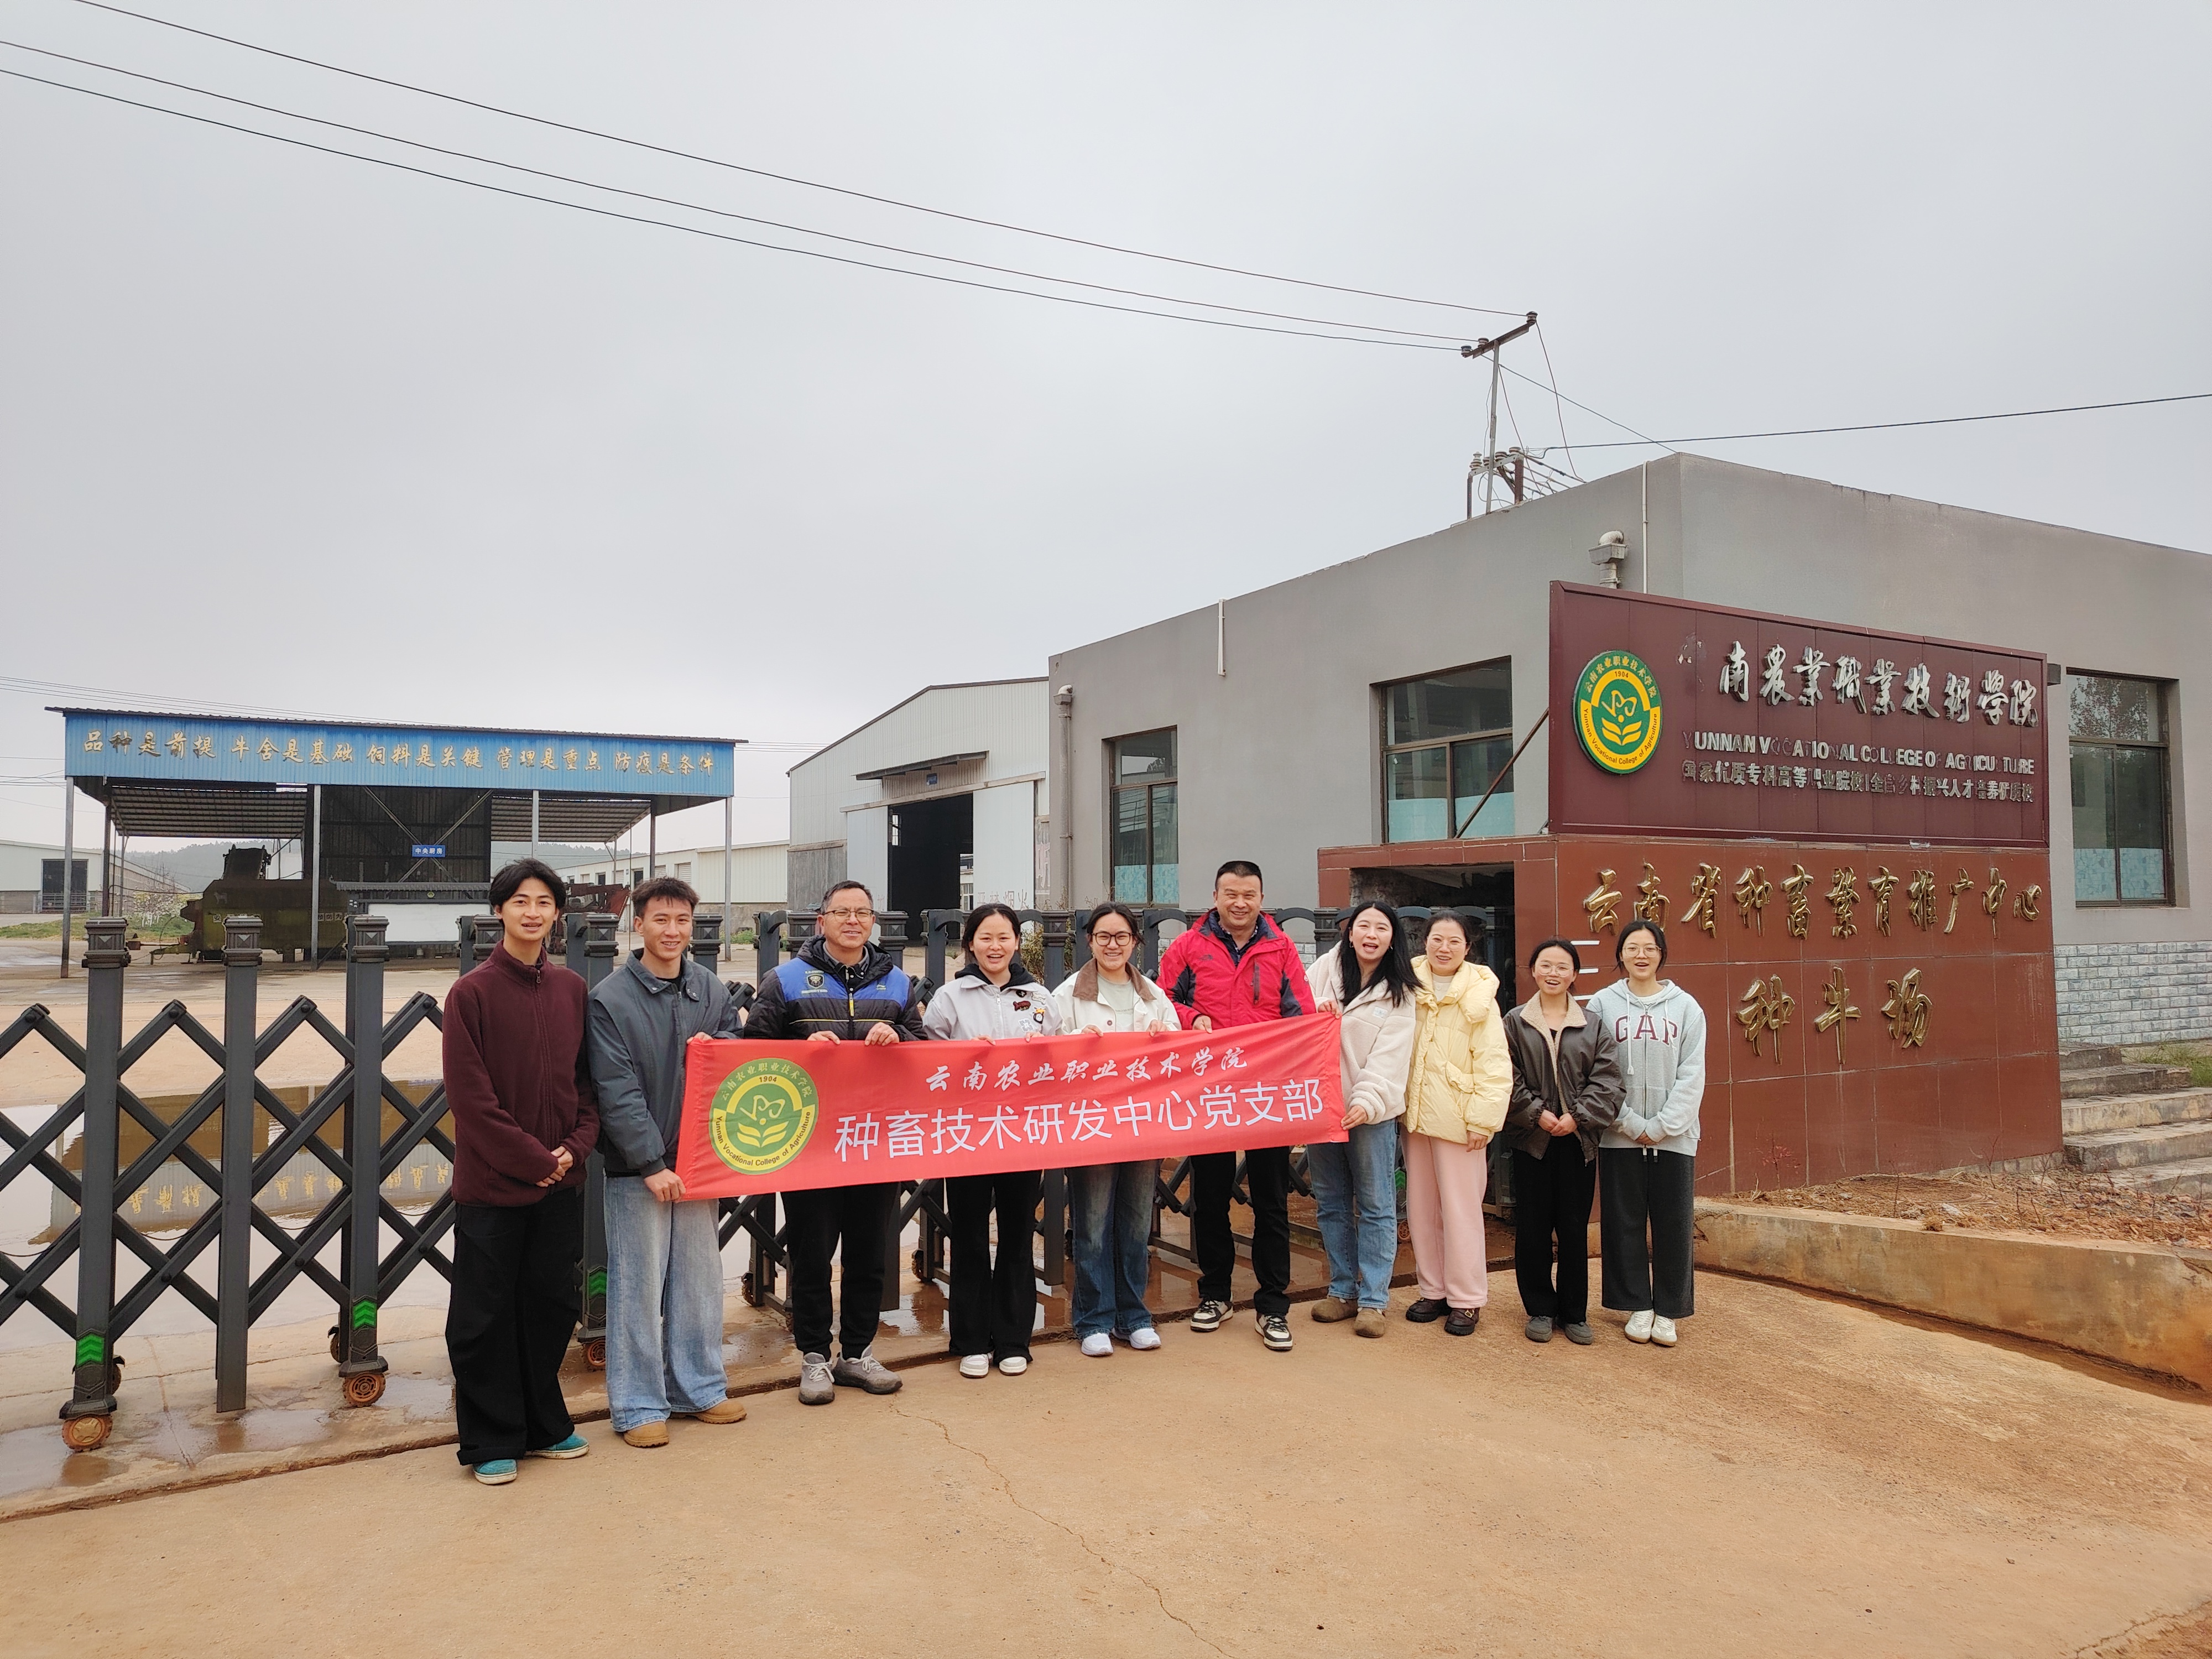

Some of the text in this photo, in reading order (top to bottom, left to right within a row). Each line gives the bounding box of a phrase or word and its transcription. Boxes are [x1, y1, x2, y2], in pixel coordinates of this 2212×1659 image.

[1584, 655, 1657, 698] 云南农业职业技术学院
[84, 729, 714, 776] 品种是前提 牛舍是基础 饲料是关键 管理是重点 防疫是条件
[1583, 708, 1593, 738] Yunnan
[1592, 738, 1618, 764] Vocational
[1619, 756, 1638, 765] College
[1644, 713, 1657, 752] Agriculture
[1583, 862, 2042, 940] 云南省种畜繁育推广中心
[1615, 1014, 1678, 1045] GAP
[1736, 965, 1934, 1065] 种牛场
[722, 1062, 813, 1101] 云南农业职业技术学院
[926, 1046, 1248, 1092] 云南农业职业技术学院
[716, 1112, 811, 1166] Yunnan Vocational College of Agriculture
[834, 1078, 1323, 1163] 种畜技术研发中心党支部
